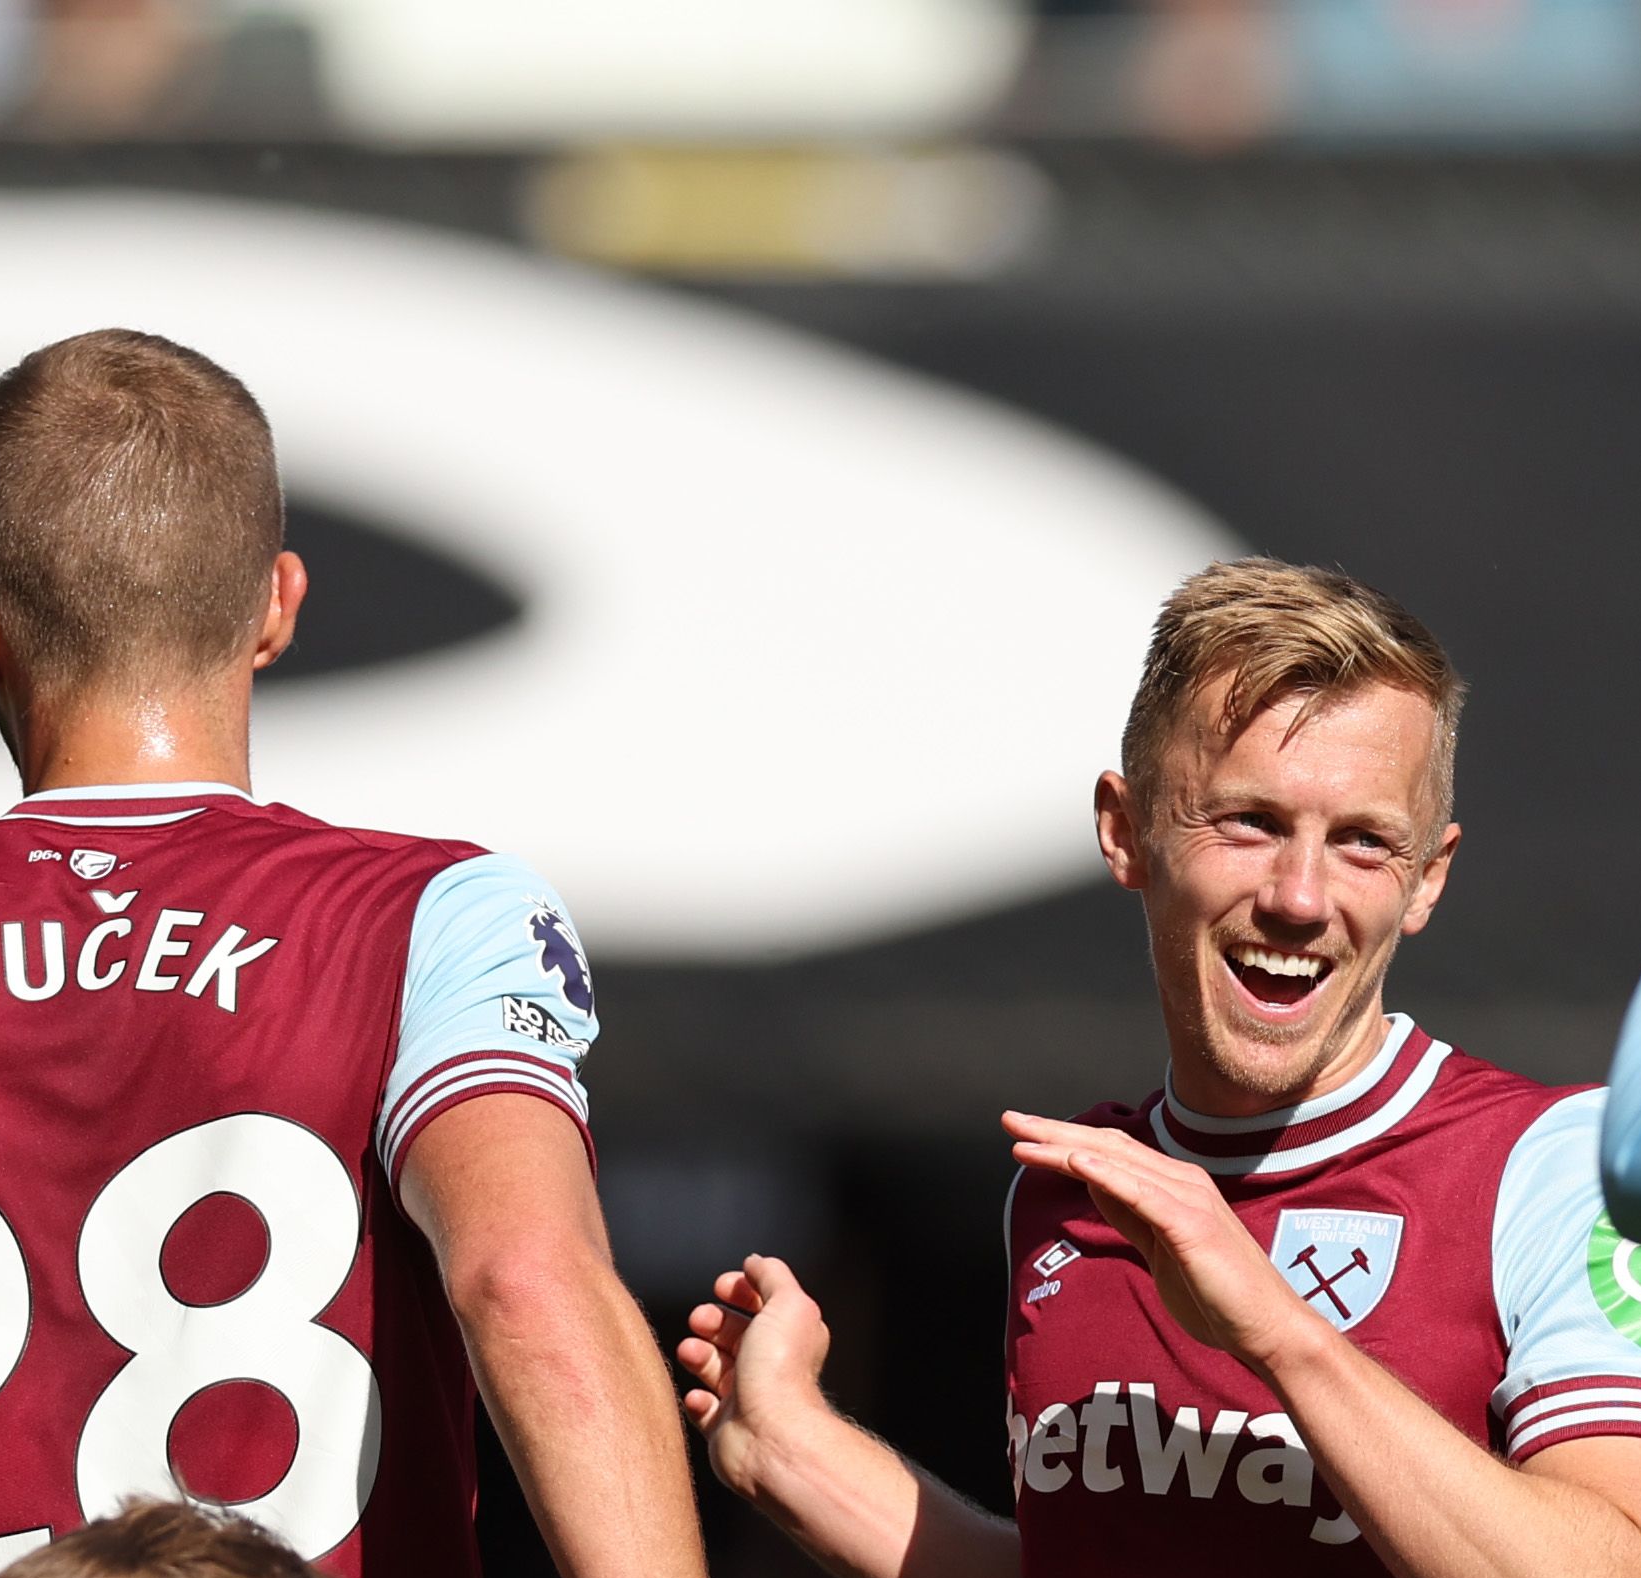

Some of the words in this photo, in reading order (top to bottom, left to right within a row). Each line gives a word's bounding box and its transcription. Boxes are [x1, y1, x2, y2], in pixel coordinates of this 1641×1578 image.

[1293, 1215, 1345, 1231] WEST
[1346, 1218, 1389, 1237] HAM
[1310, 1229, 1368, 1245] UNITED
